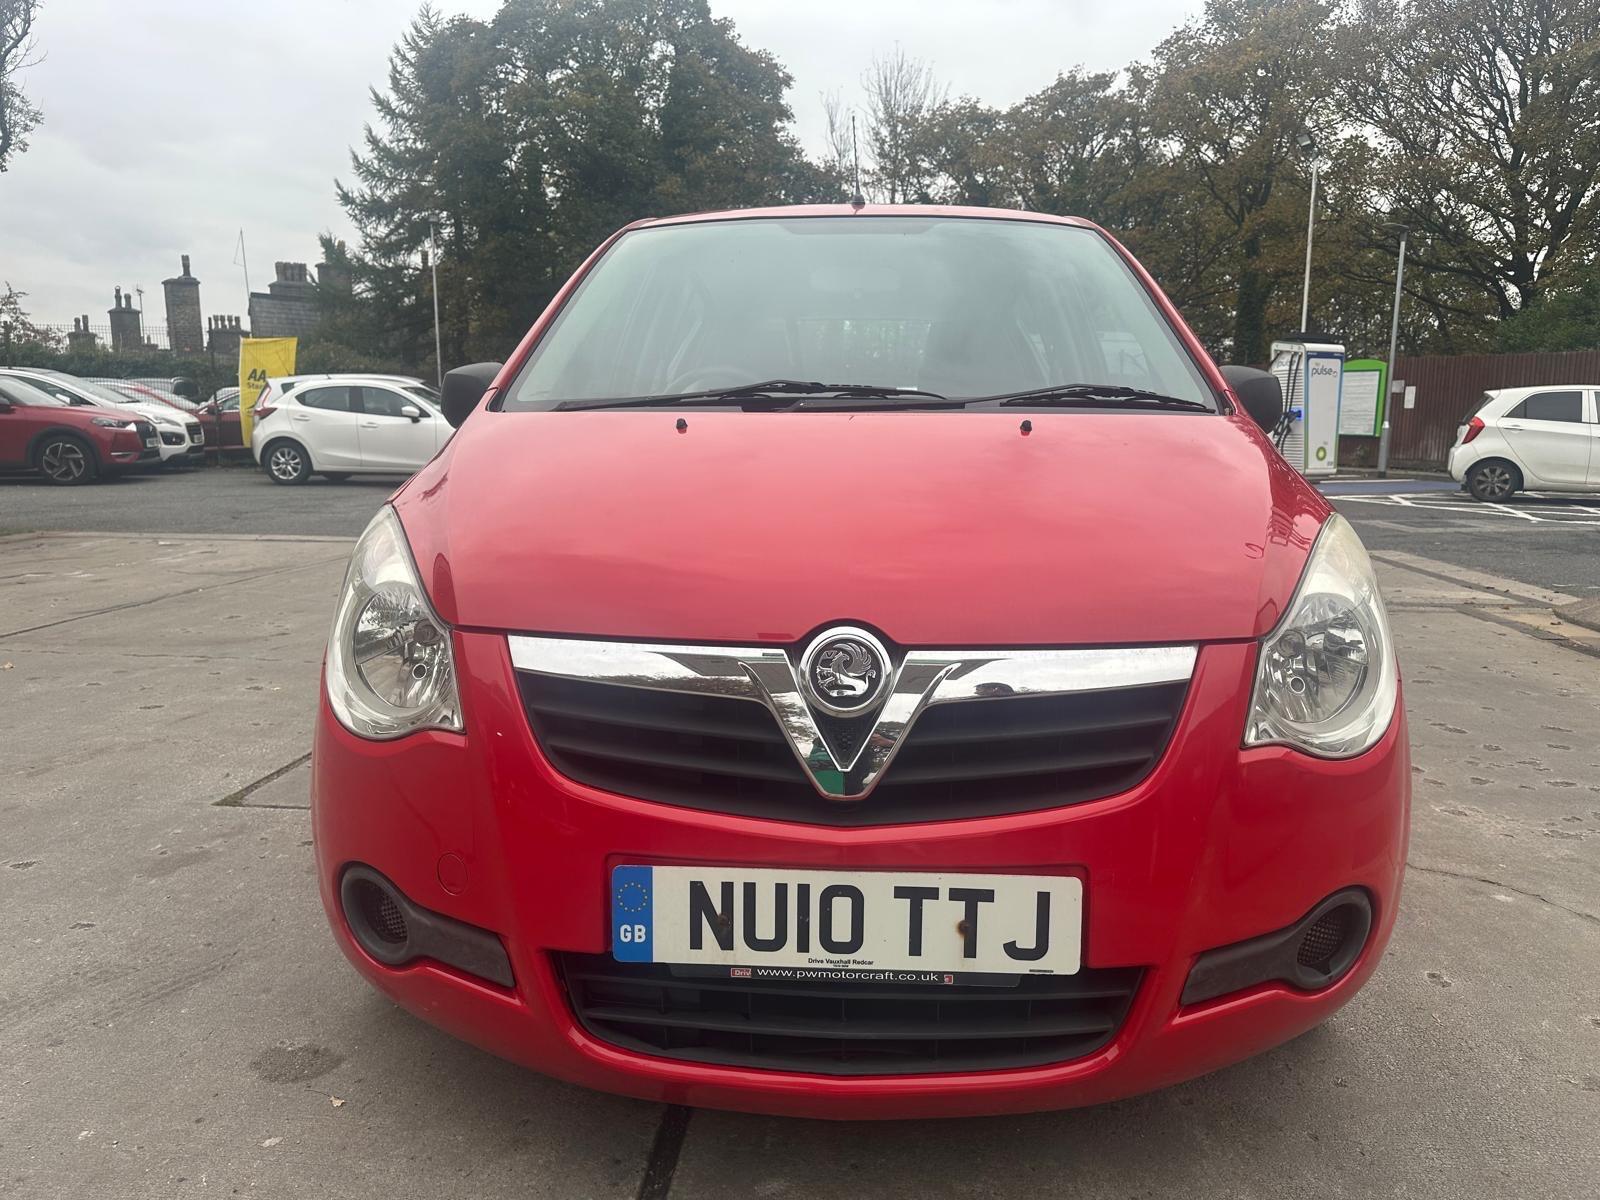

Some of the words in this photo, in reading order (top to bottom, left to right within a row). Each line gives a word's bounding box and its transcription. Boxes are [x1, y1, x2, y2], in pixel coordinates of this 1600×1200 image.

[247, 369, 266, 382] AA
[1311, 364, 1333, 377] pulse
[689, 880, 865, 954] NU10
[893, 885, 1052, 961] TTJ
[620, 924, 646, 943] GB
[757, 968, 939, 981] www.pwmotorcraft.co.uk
